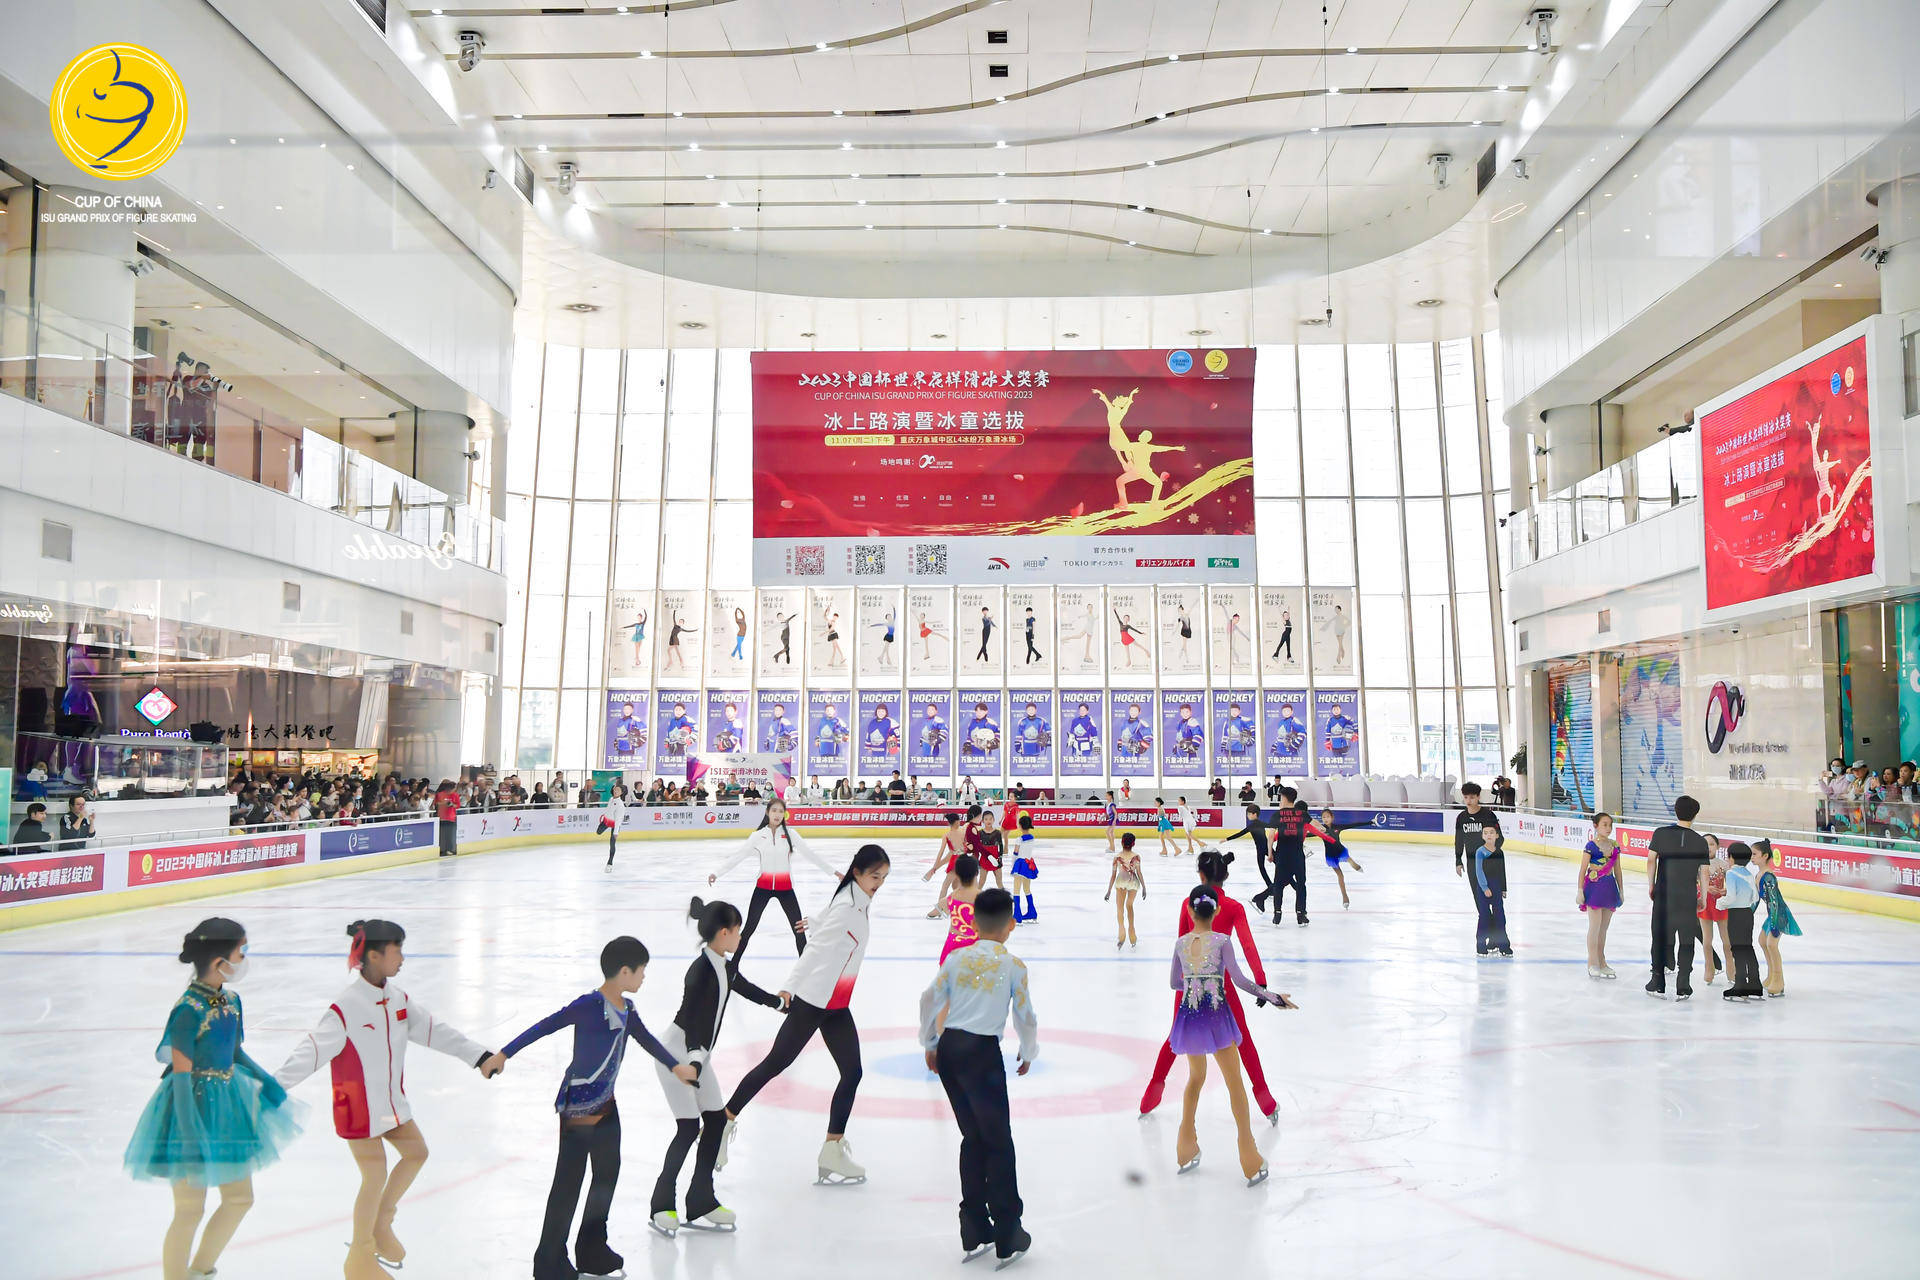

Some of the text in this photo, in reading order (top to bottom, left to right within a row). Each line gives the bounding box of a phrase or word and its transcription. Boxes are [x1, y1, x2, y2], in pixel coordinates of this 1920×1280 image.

[814, 391, 1032, 400] CUP OF CHINA ISU GRAND PRIX OF FIGURE SKATING 2023
[823, 410, 1024, 431] 冰上路演暨冰童选拔
[1140, 559, 1191, 567] オリエンタルバイオ
[610, 693, 648, 703] HOCKEY
[661, 693, 698, 703] HOCKEY
[711, 693, 748, 703] HOCKEY
[761, 693, 798, 703] HOCKEY
[812, 693, 849, 703] HOCKEY
[862, 693, 899, 703] HOCKEY
[912, 693, 949, 703] HOCKEY
[962, 693, 999, 703] HOCKEY
[1013, 693, 1050, 703] HOCKEY
[1063, 693, 1101, 703] HOCKEY
[1114, 693, 1151, 703] HOCKEY
[1165, 693, 1202, 703] HOCKEY
[1216, 693, 1254, 703] HOCKEY
[1267, 693, 1305, 703] HOCKEY
[1318, 693, 1356, 703] HOCKEY
[1463, 823, 1482, 833] CHINA
[0, 865, 94, 892] 冰大奖赛精彩绽放
